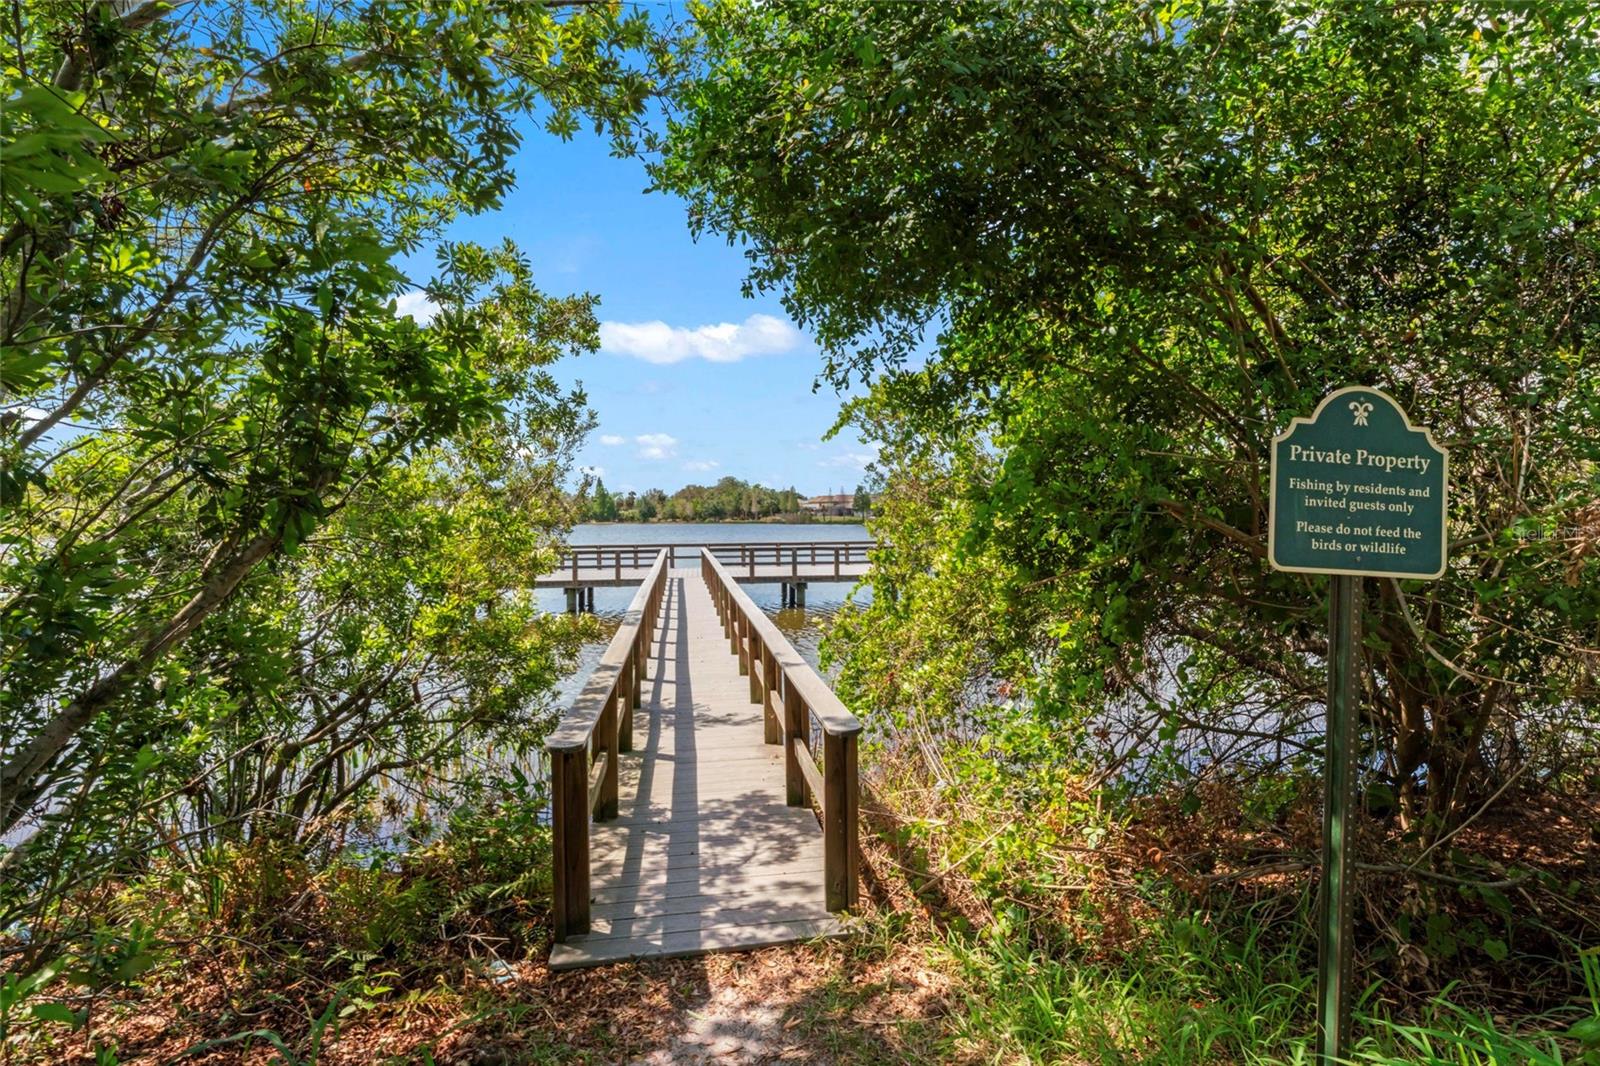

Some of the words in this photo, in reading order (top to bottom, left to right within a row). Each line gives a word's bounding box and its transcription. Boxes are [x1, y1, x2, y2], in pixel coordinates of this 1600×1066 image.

[1289, 444, 1351, 464] Private
[1356, 449, 1430, 475] Property
[1289, 478, 1333, 493] Fishing
[1336, 481, 1351, 495] by
[1354, 483, 1406, 496] residents
[1409, 486, 1430, 497] and
[1305, 496, 1346, 509] invited
[1349, 500, 1386, 512] guests
[1389, 502, 1414, 515] only
[1296, 521, 1333, 533] Please
[1336, 524, 1350, 535] do
[1353, 526, 1372, 536] not
[1375, 526, 1400, 537] feed
[1403, 528, 1421, 539] the
[1312, 539, 1342, 551] birds
[1345, 544, 1357, 552] or
[1360, 543, 1406, 555] wildlife
